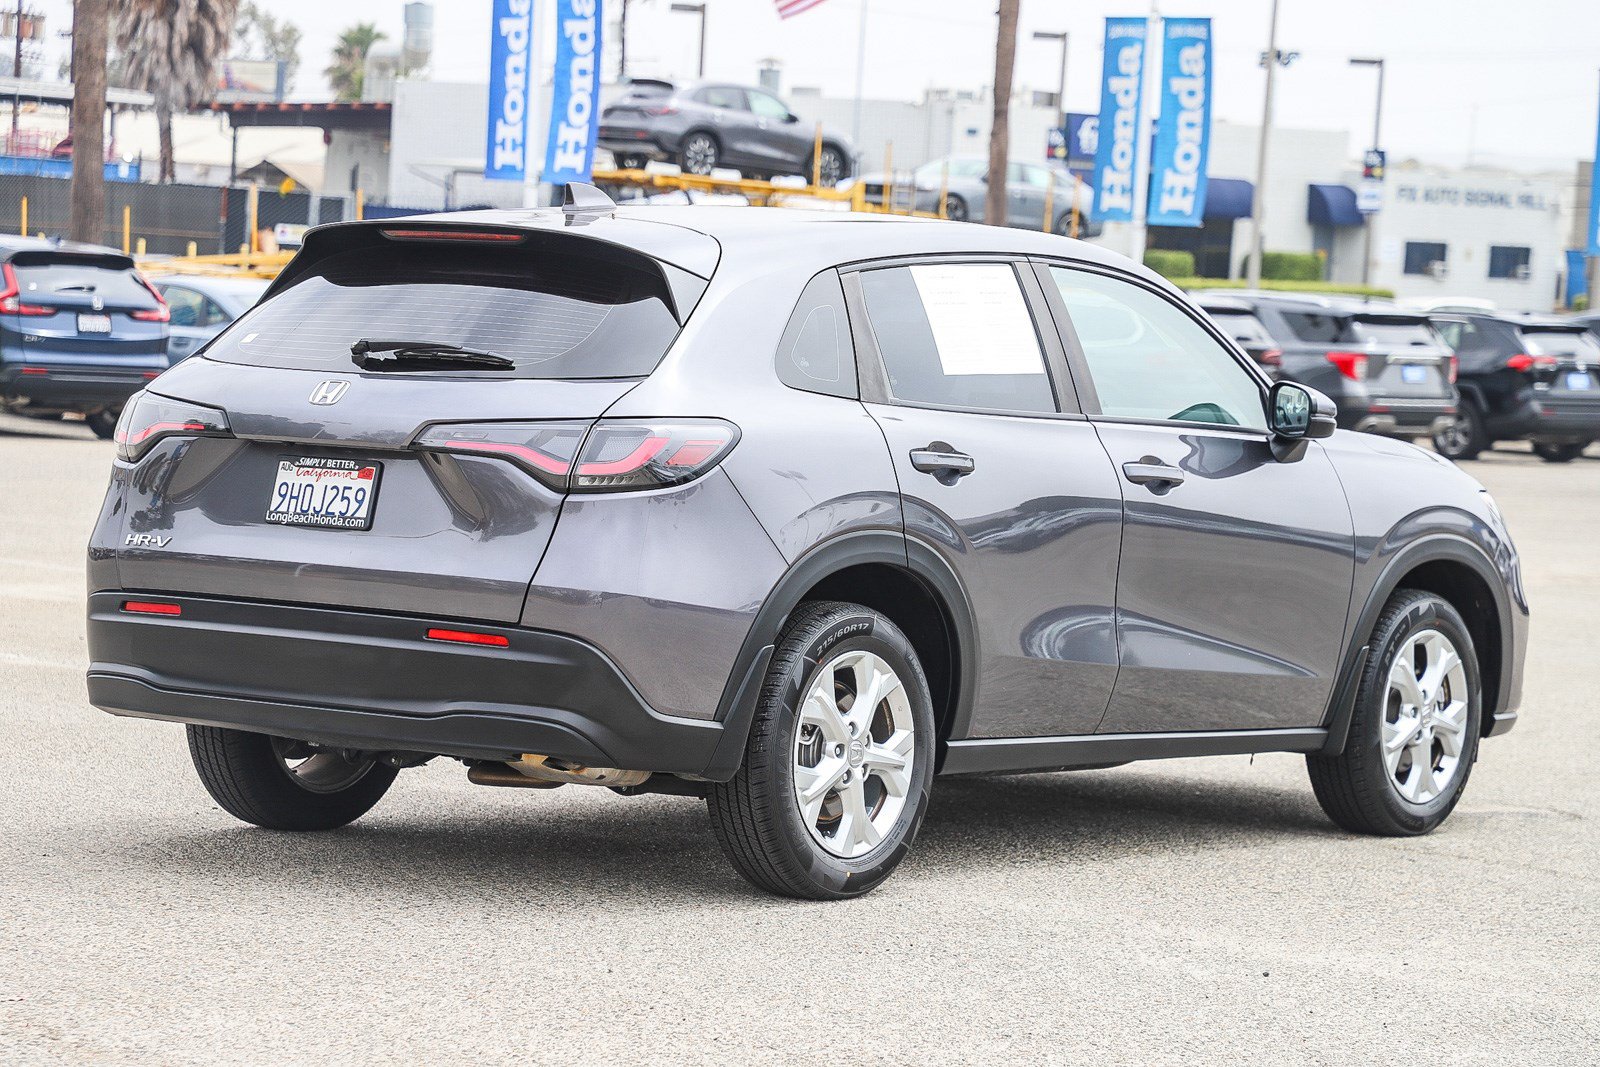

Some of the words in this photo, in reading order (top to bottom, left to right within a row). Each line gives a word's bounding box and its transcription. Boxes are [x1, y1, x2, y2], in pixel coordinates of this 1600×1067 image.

[1101, 43, 1142, 213] Honda
[1159, 43, 1206, 215] Honda
[280, 462, 294, 471] AUG
[296, 467, 358, 482] California
[266, 510, 365, 527] LongBeachHonda.com
[125, 534, 172, 547] HR-V
[816, 622, 870, 656] 215/60R17
